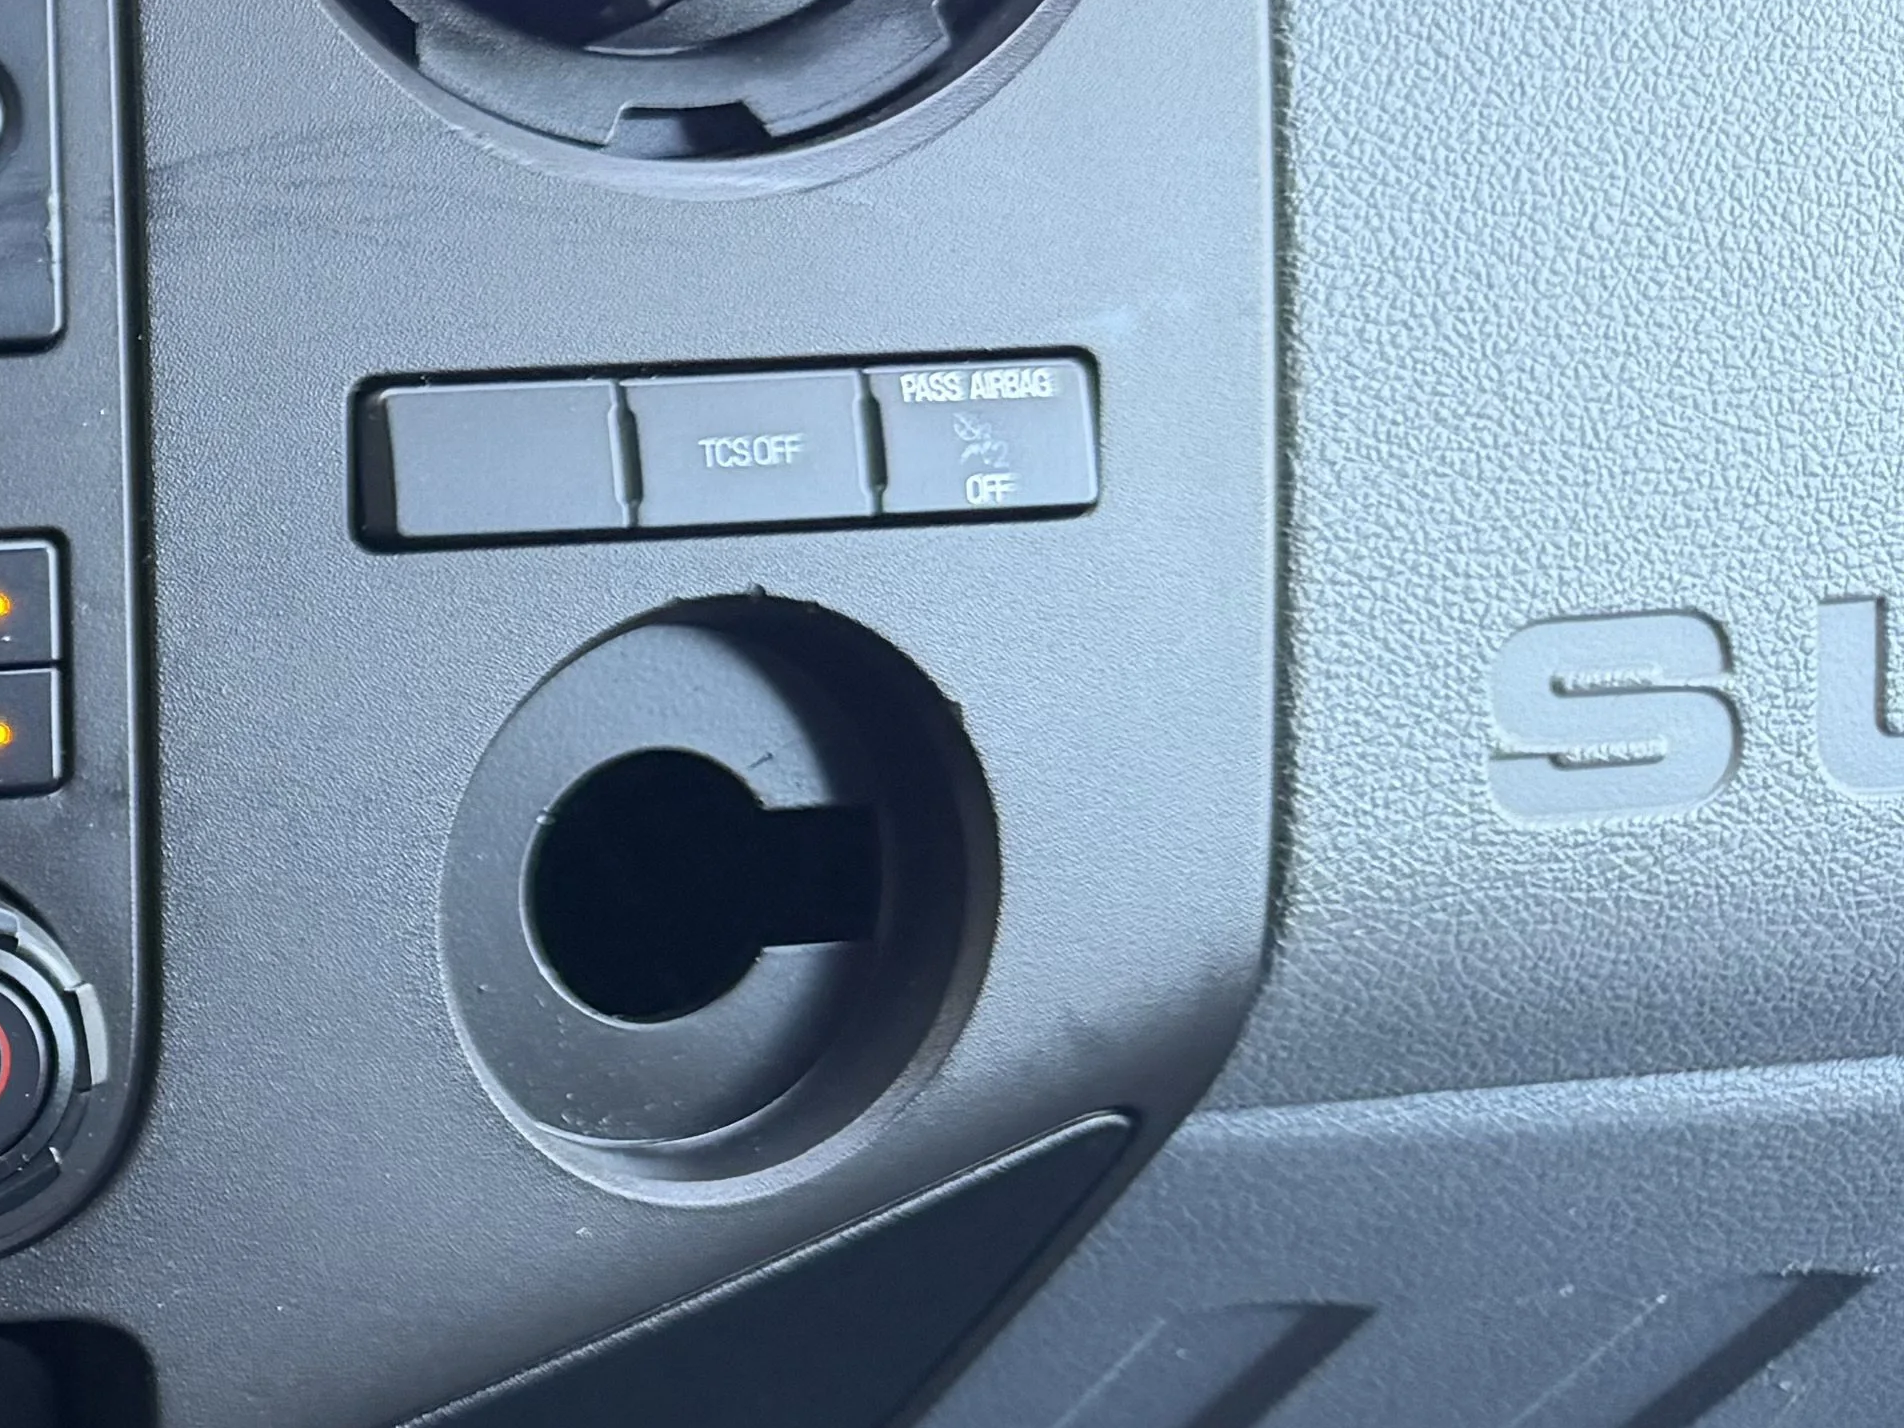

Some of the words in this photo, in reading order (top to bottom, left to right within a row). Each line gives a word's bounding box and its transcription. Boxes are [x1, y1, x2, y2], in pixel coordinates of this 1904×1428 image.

[899, 371, 966, 403] PASS
[969, 367, 1055, 400] AIRBAG
[697, 436, 753, 468] TCS
[752, 433, 806, 466] OFF
[965, 472, 1019, 505] OFF
